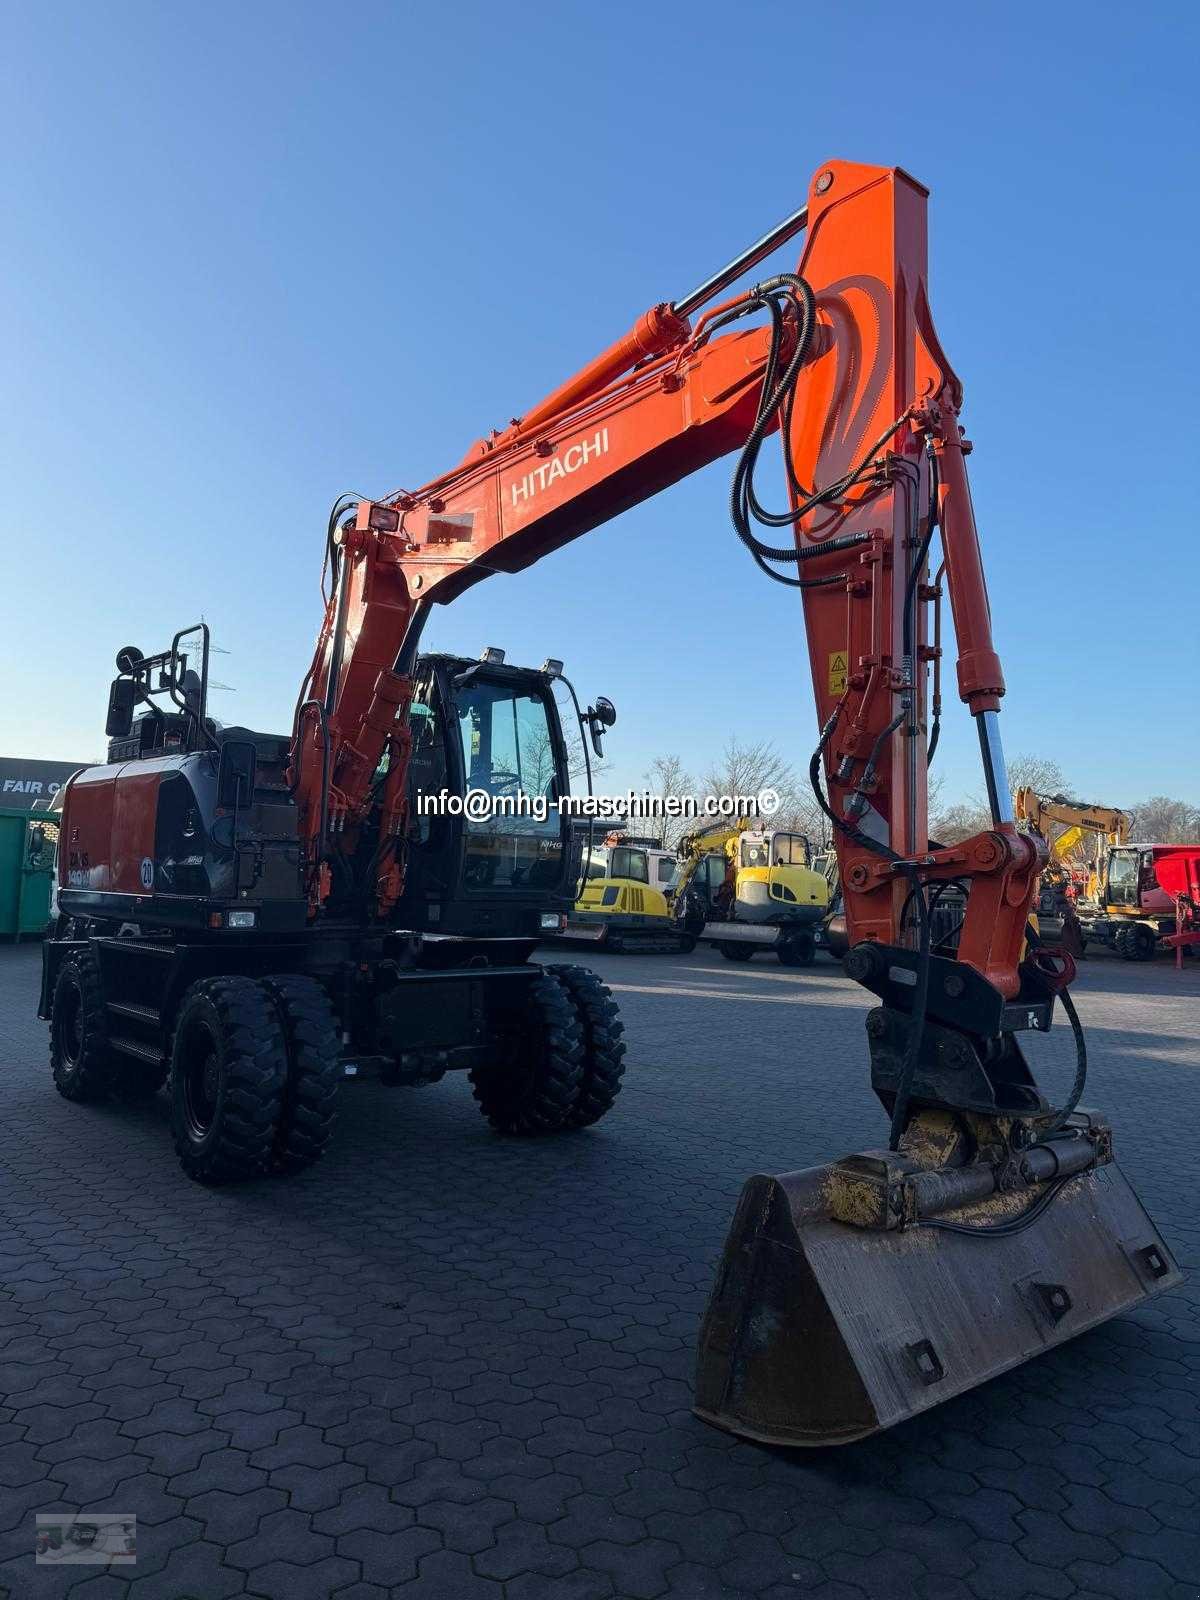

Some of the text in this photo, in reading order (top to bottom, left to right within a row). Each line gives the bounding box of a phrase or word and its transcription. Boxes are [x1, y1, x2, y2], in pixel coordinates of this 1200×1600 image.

[511, 428, 608, 506] HITACHI
[3, 780, 42, 793] FAIR
[142, 862, 153, 884] 20
